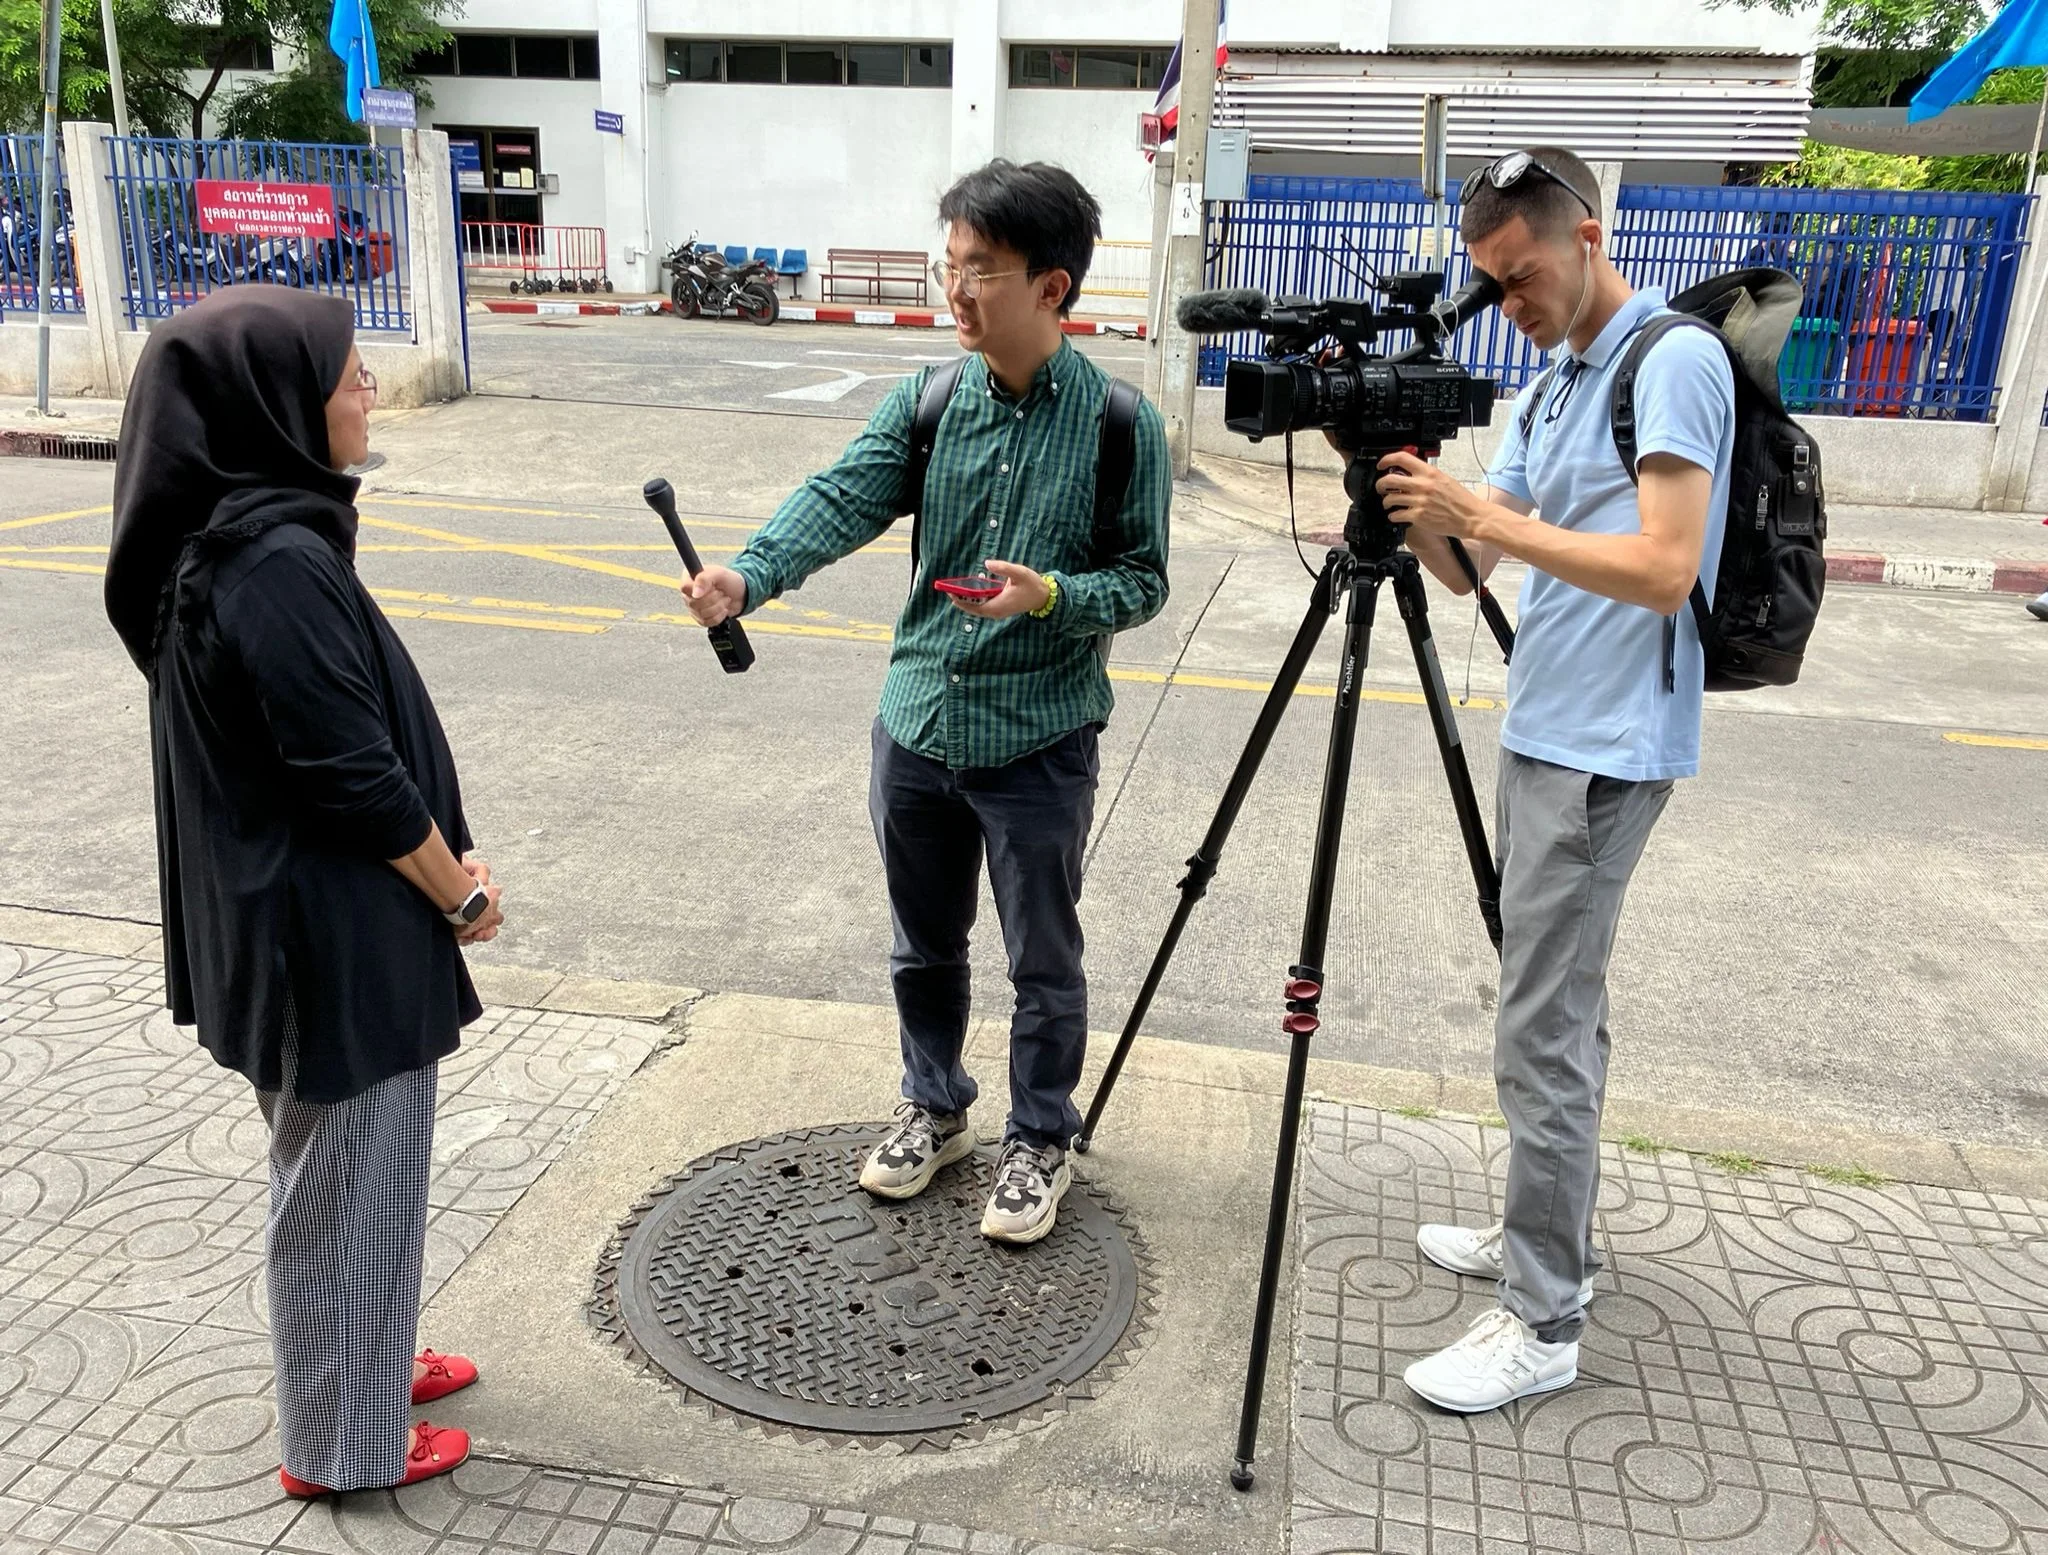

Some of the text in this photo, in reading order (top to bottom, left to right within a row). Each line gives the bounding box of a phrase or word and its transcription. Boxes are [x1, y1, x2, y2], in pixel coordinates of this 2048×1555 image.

[223, 184, 309, 206] สถานที่ราชการ
[203, 205, 331, 225] บุคคลภายนอกห้ามเข้า
[1344, 655, 1355, 690] sachtler
